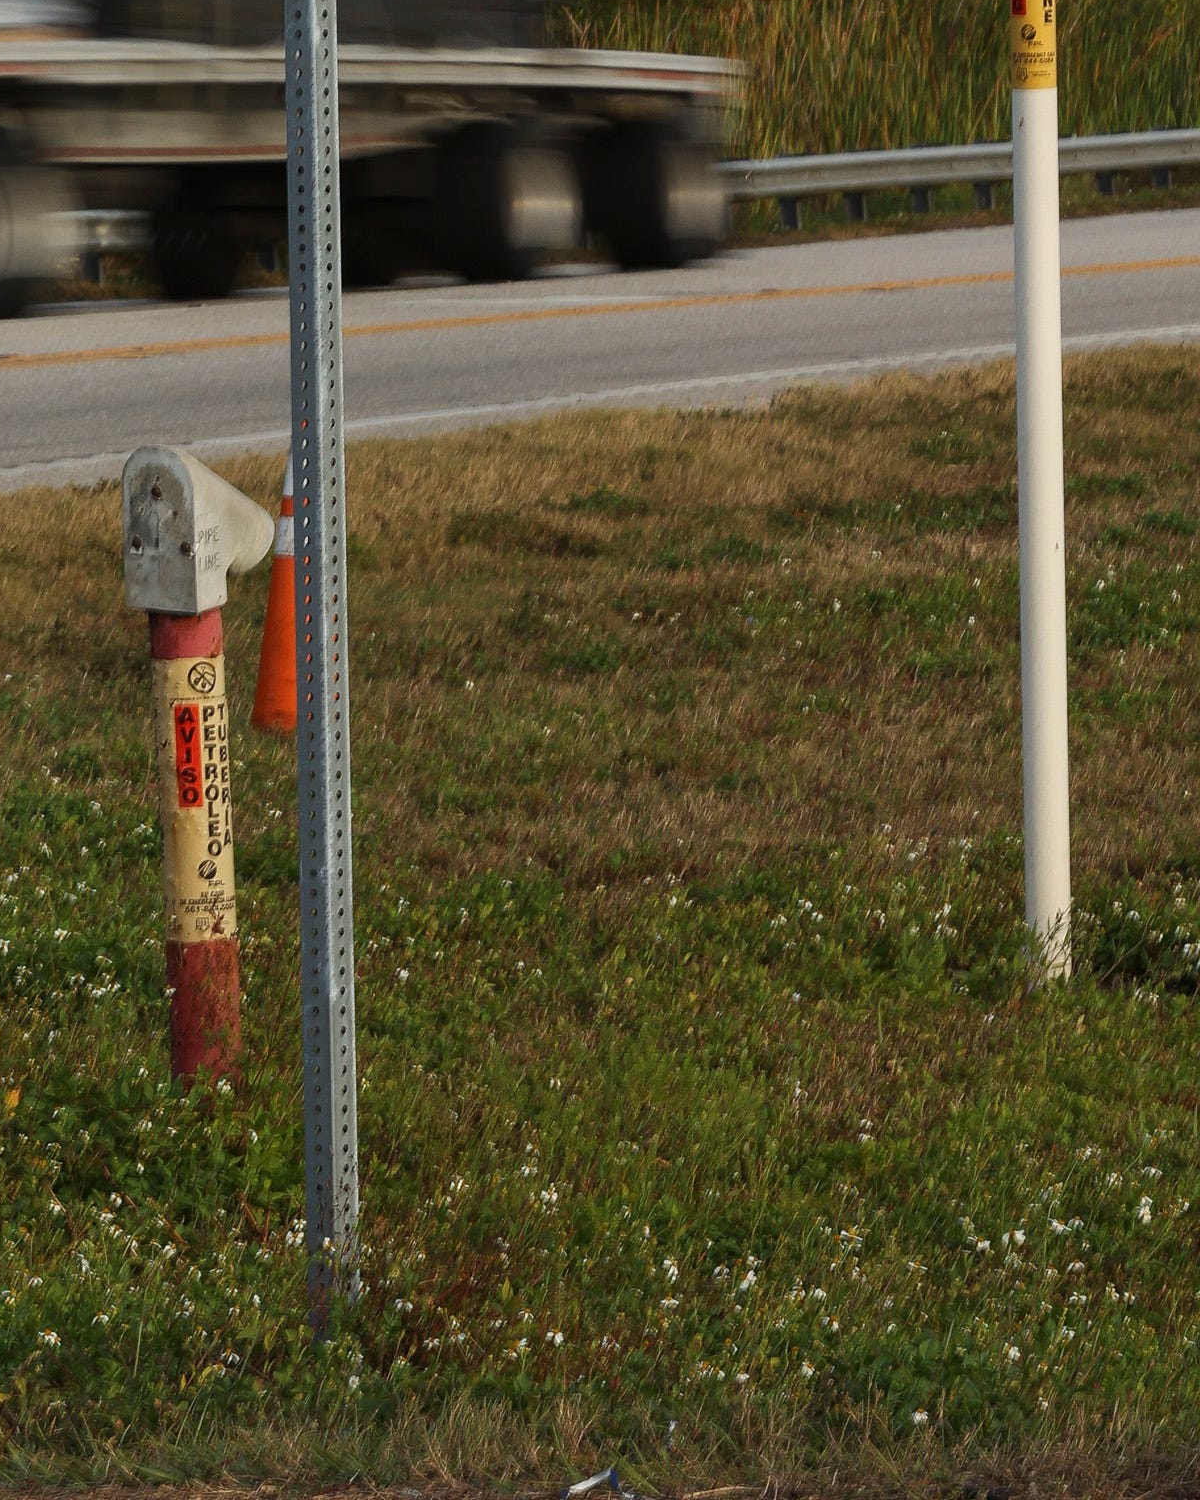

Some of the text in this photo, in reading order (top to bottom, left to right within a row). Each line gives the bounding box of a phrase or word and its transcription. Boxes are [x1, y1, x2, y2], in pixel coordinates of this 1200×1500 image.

[178, 706, 199, 804] AVISO
[202, 704, 222, 857] PETRÓLEO
[217, 703, 232, 847] TUBERÍA
